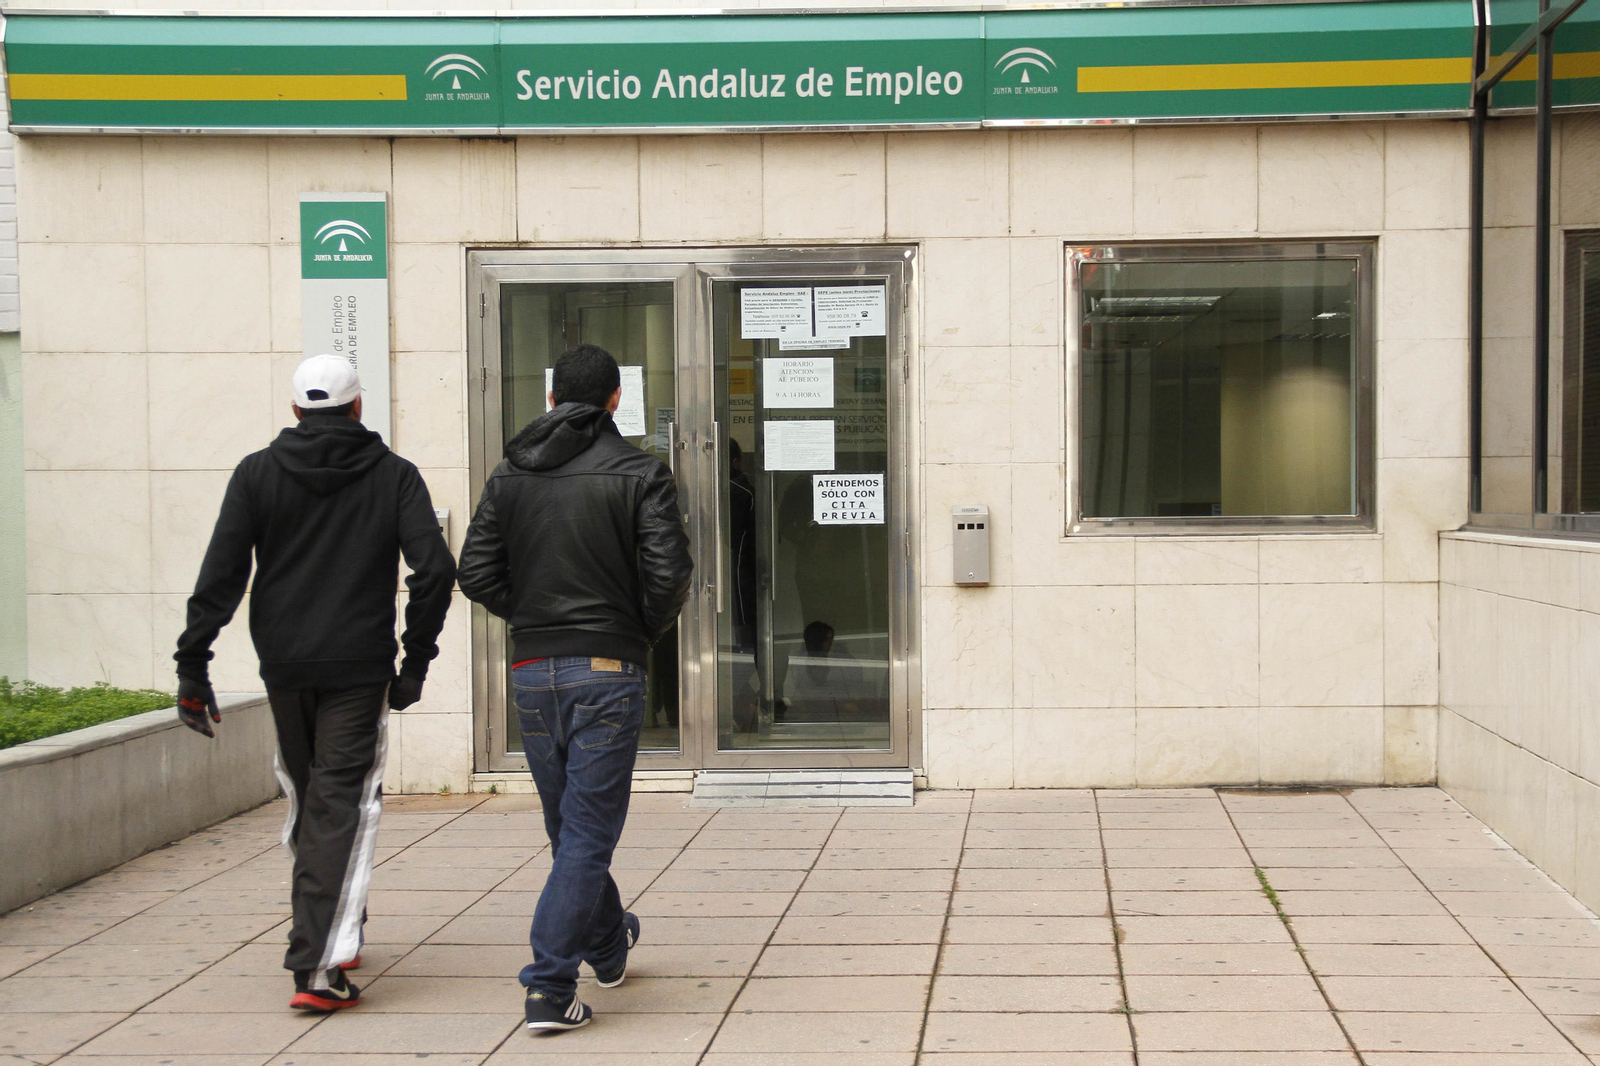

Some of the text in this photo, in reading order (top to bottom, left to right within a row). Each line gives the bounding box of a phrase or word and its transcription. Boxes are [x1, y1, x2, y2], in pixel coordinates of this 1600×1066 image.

[516, 66, 963, 104] Servicio Andaluz de Empleo
[332, 295, 345, 352] de Empleo
[348, 295, 356, 332] EMPLEO
[348, 335, 356, 347] DE
[821, 489, 848, 498] SÓLO
